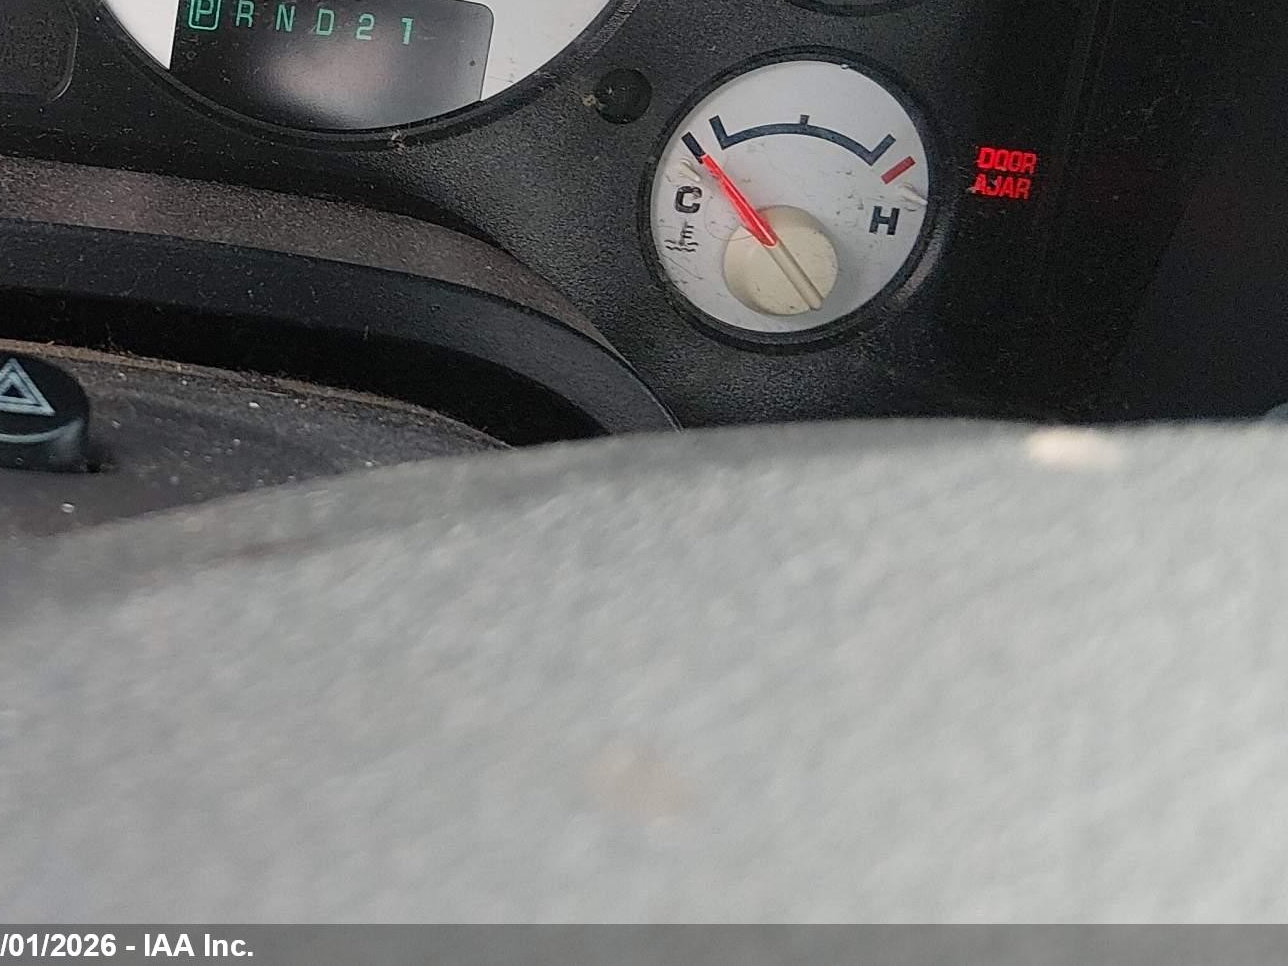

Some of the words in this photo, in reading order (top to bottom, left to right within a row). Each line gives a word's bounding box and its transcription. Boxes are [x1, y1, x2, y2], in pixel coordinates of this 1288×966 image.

[236, 0, 255, 27] R
[275, 4, 296, 32] N
[316, 8, 336, 36] D
[356, 13, 376, 40] 2
[401, 17, 414, 45] 1
[977, 147, 1037, 173] DOOR
[970, 173, 1031, 199] AJAR
[675, 186, 702, 216] C
[869, 206, 900, 235] H
